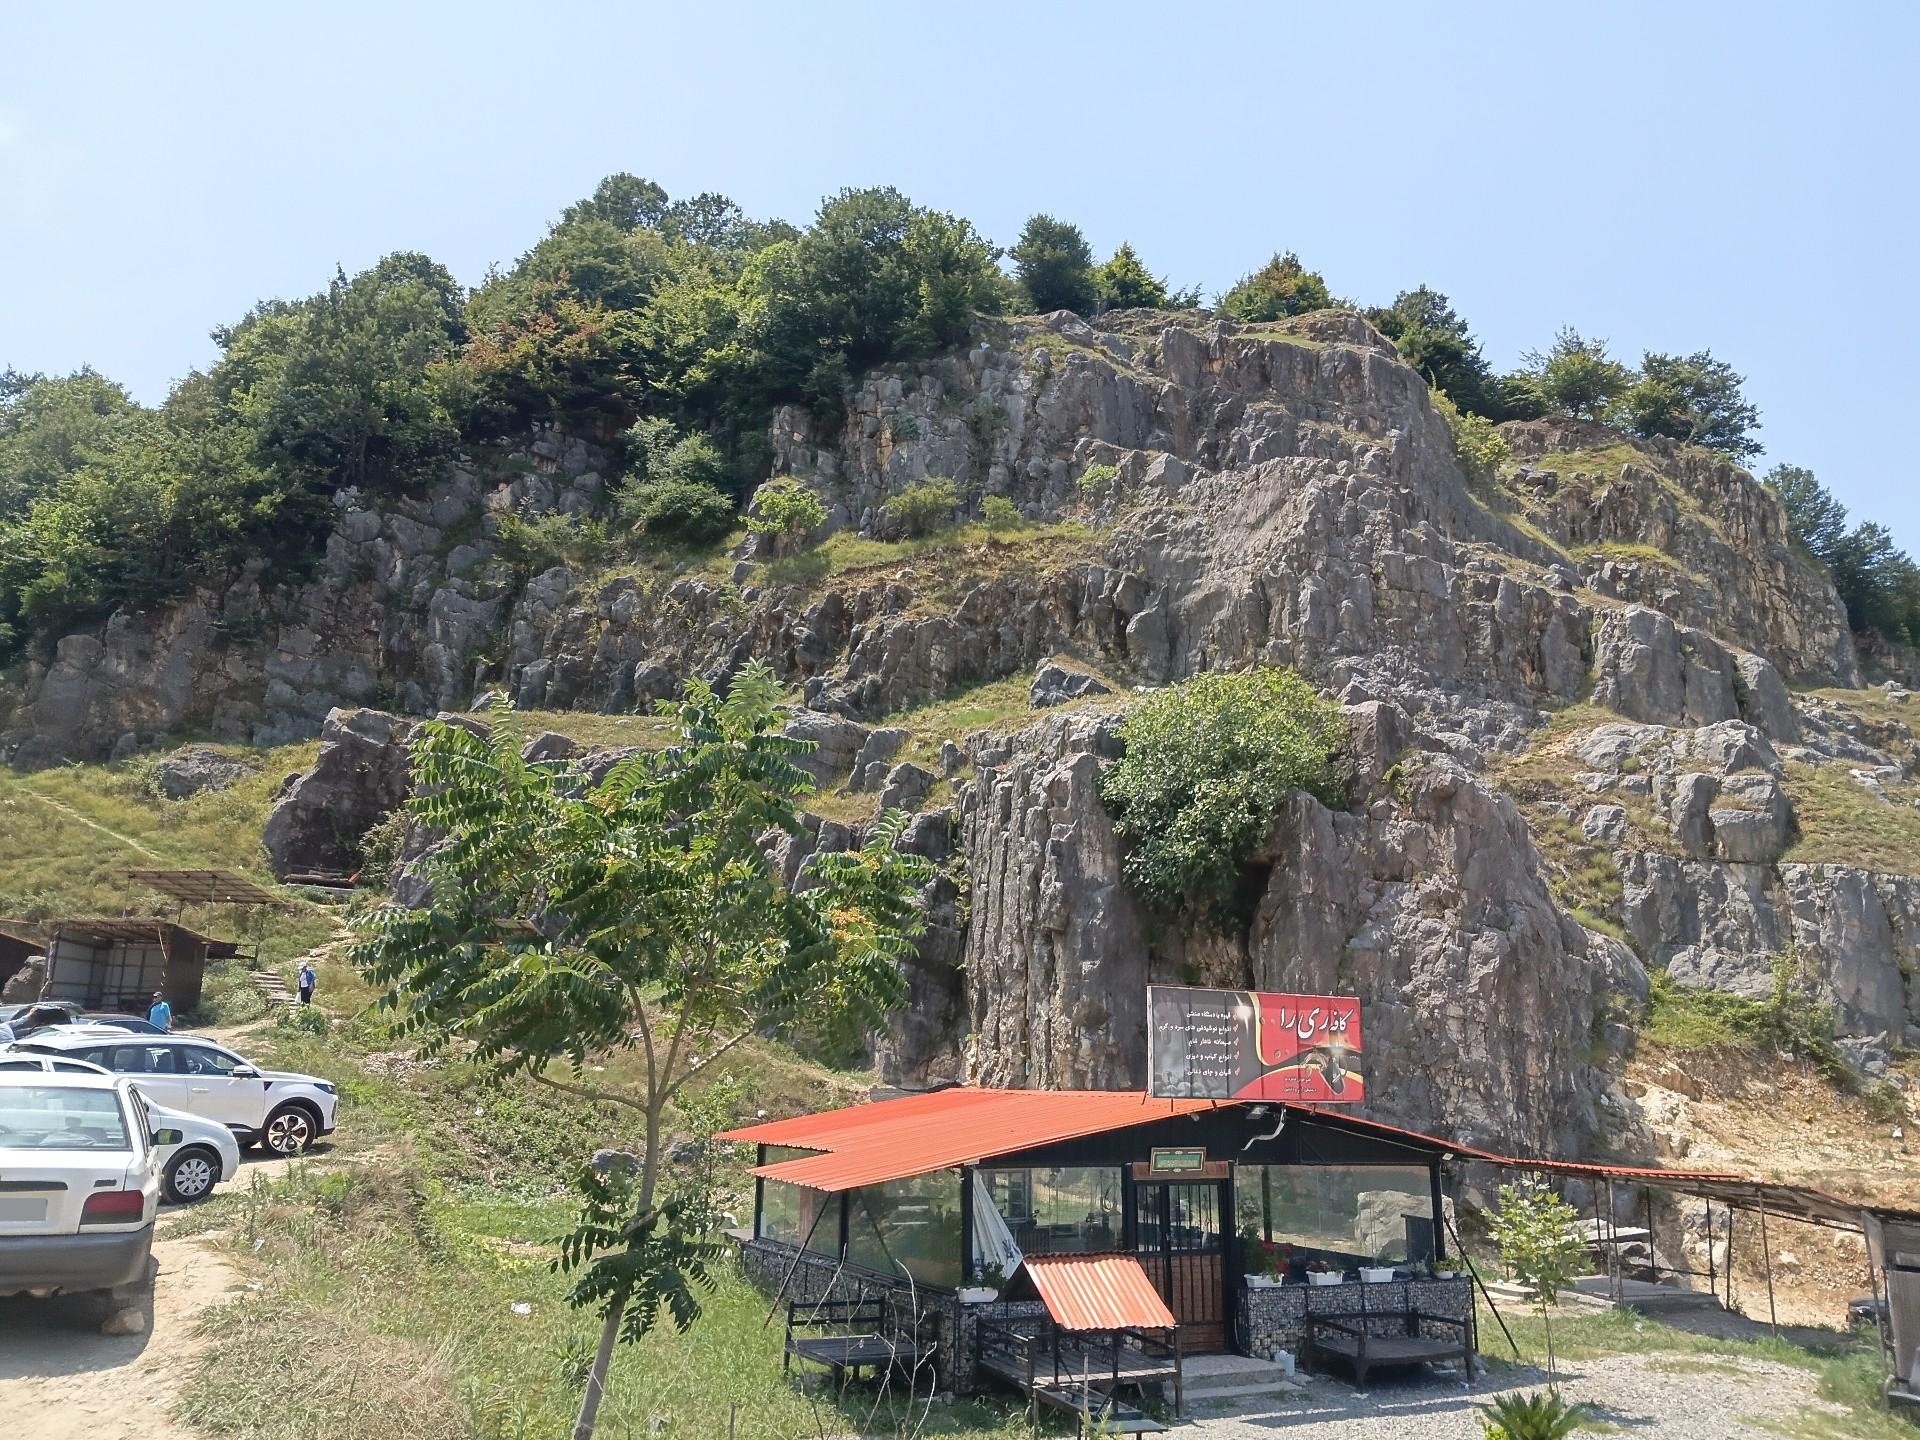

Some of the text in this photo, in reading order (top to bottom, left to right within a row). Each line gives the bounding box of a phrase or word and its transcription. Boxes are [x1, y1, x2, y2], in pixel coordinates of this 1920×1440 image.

[1174, 1024, 1184, 1032] سرد
[1218, 1025, 1232, 1035] انواع
[1218, 1053, 1232, 1063] انواع
